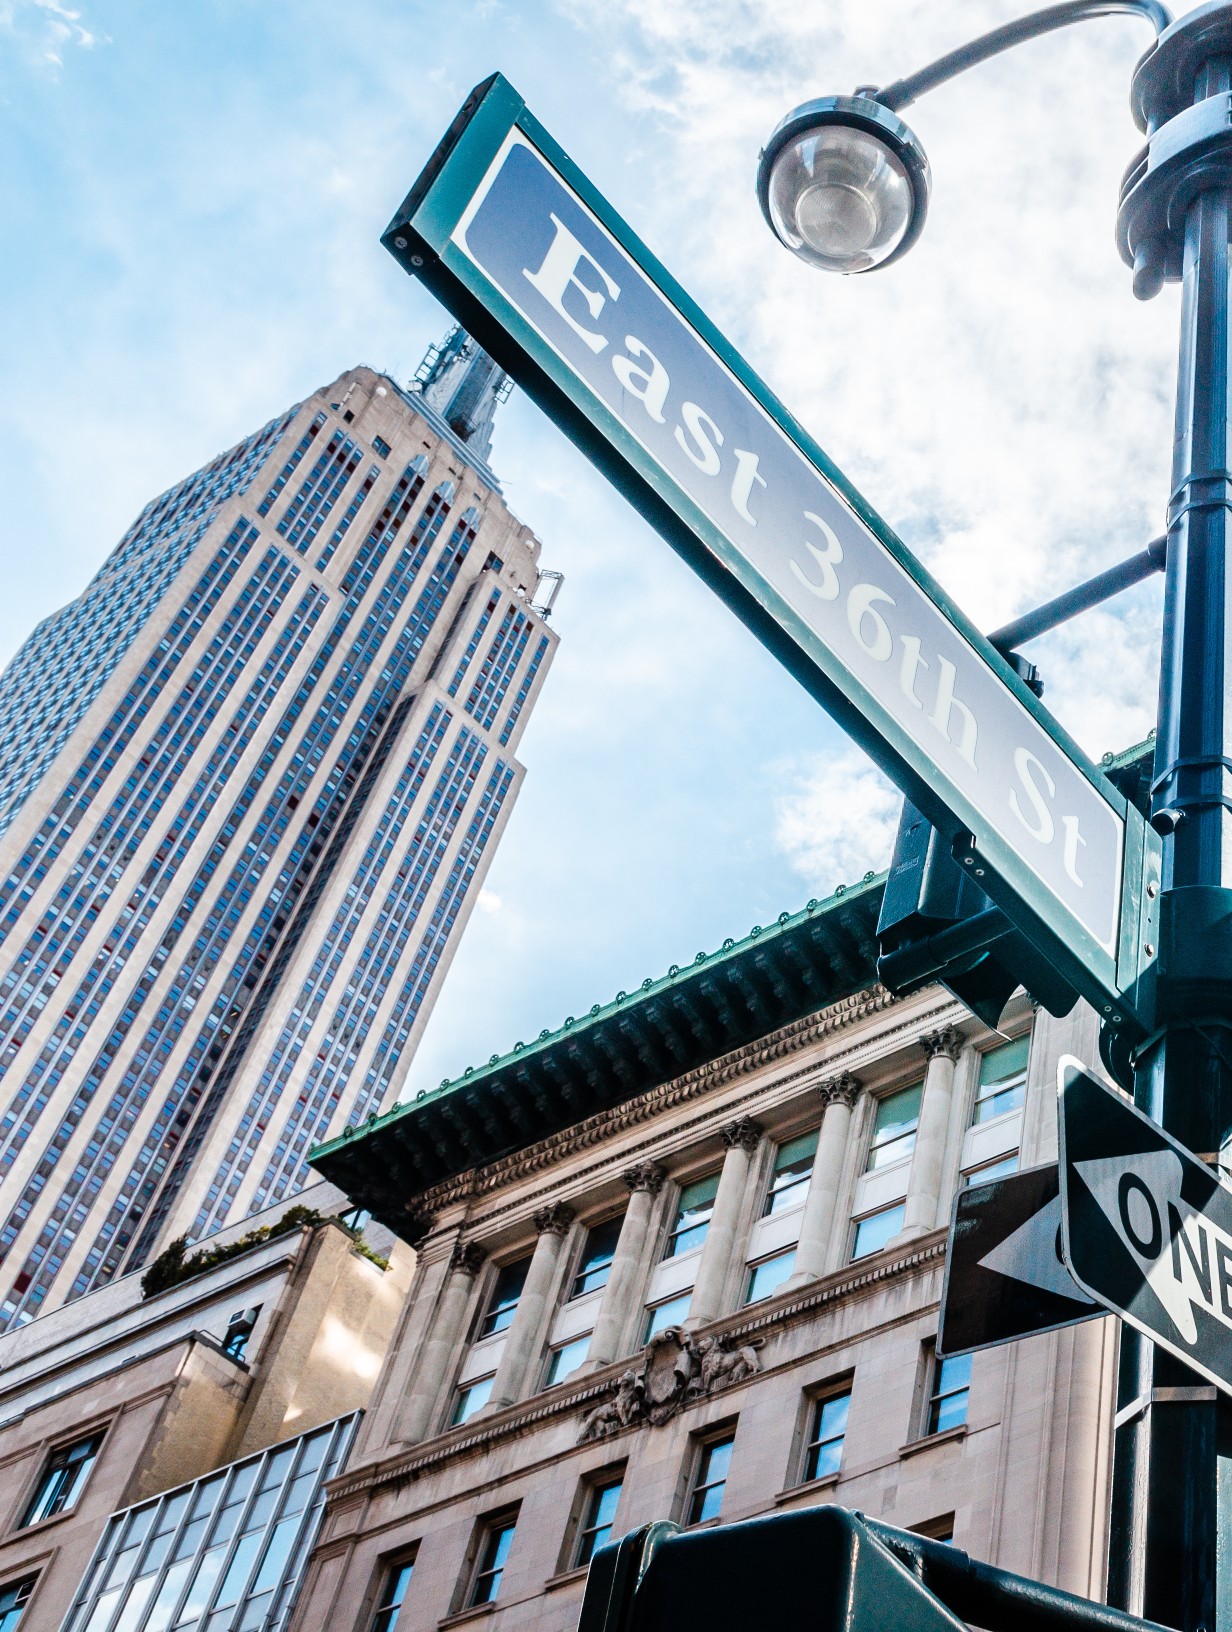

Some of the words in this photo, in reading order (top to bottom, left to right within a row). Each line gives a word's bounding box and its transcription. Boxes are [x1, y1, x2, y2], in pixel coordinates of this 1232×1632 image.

[522, 212, 768, 528] East
[788, 510, 980, 775] 36th
[1009, 747, 1087, 888] St
